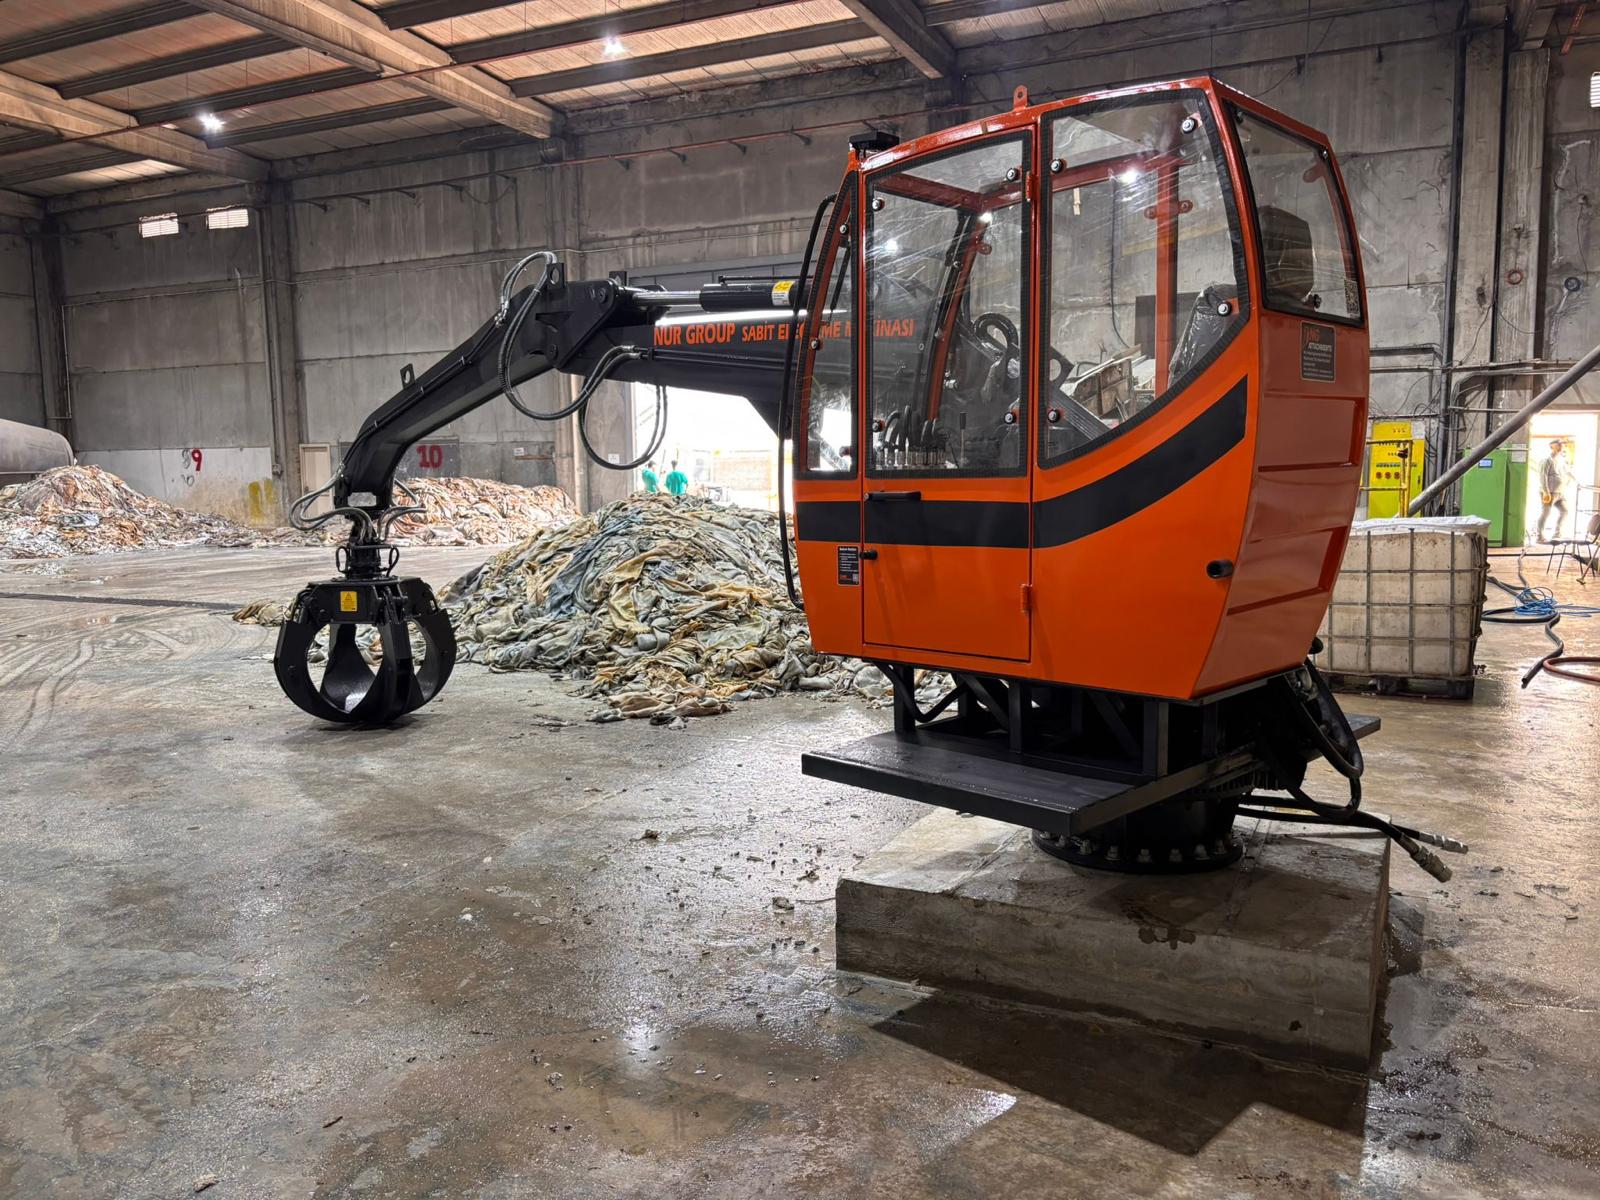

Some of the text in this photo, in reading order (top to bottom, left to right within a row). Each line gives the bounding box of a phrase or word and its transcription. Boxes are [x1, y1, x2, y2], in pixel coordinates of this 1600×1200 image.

[653, 325, 682, 346] NUR
[685, 322, 735, 345] GROUP
[742, 320, 775, 342] SABİT
[191, 449, 203, 472] 9
[416, 444, 443, 468] 10
